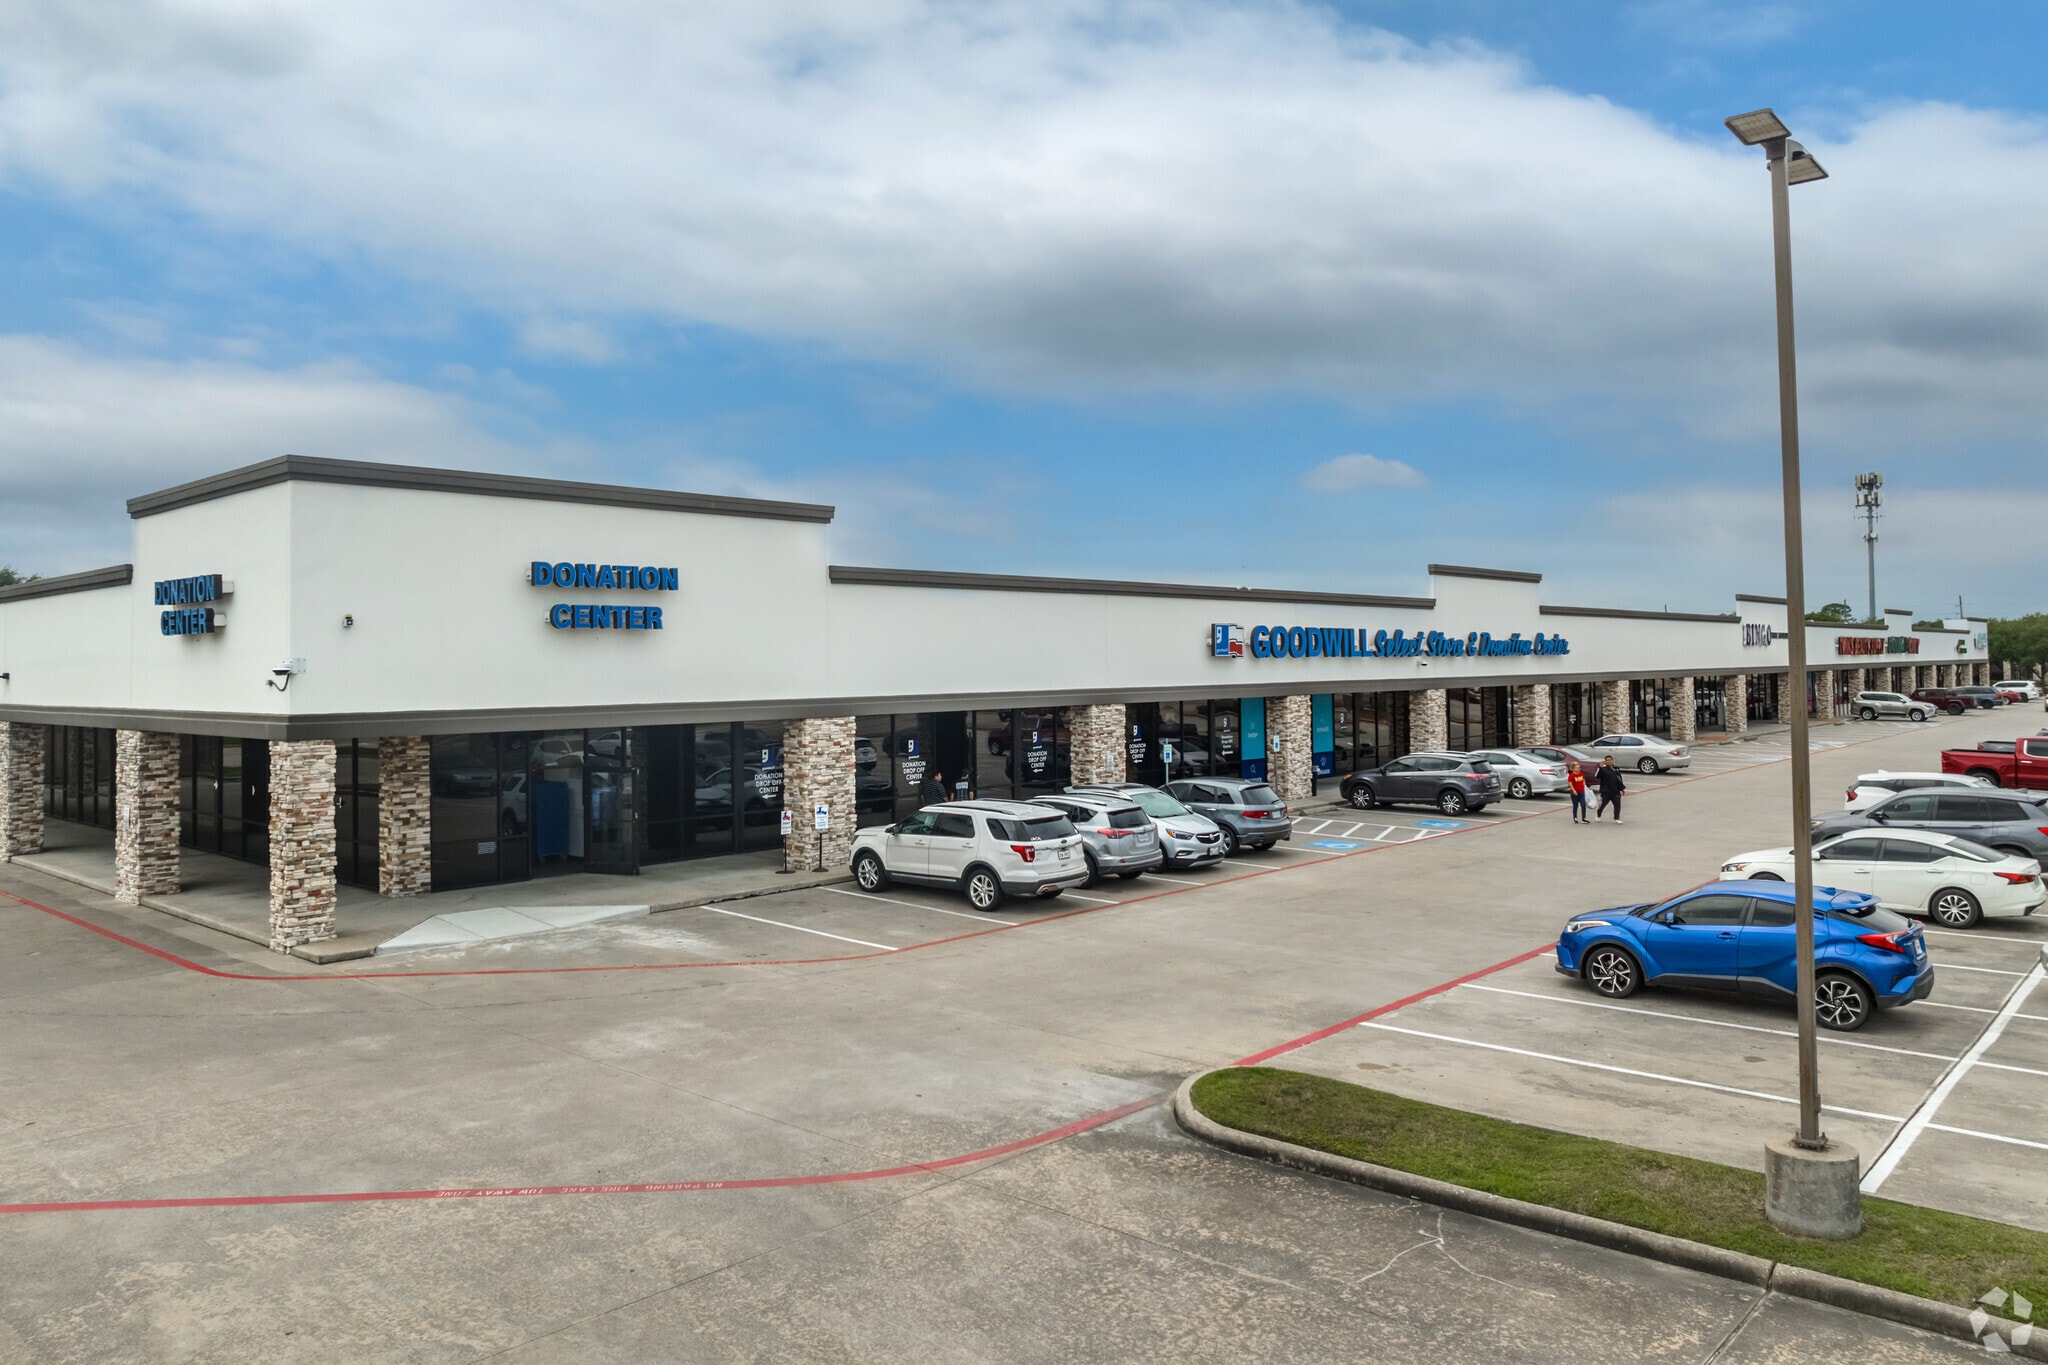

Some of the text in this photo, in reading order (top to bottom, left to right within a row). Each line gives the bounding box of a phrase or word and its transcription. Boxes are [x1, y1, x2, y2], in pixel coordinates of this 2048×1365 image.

[155, 575, 220, 605] DONATION
[532, 562, 678, 591] DONATION
[161, 608, 211, 636] CENTER
[551, 604, 663, 630] CENTER
[1251, 625, 1570, 659] GOODWILL Select Store & Donation Center
[755, 772, 783, 781] DONATION
[759, 786, 779, 794] CENTER
